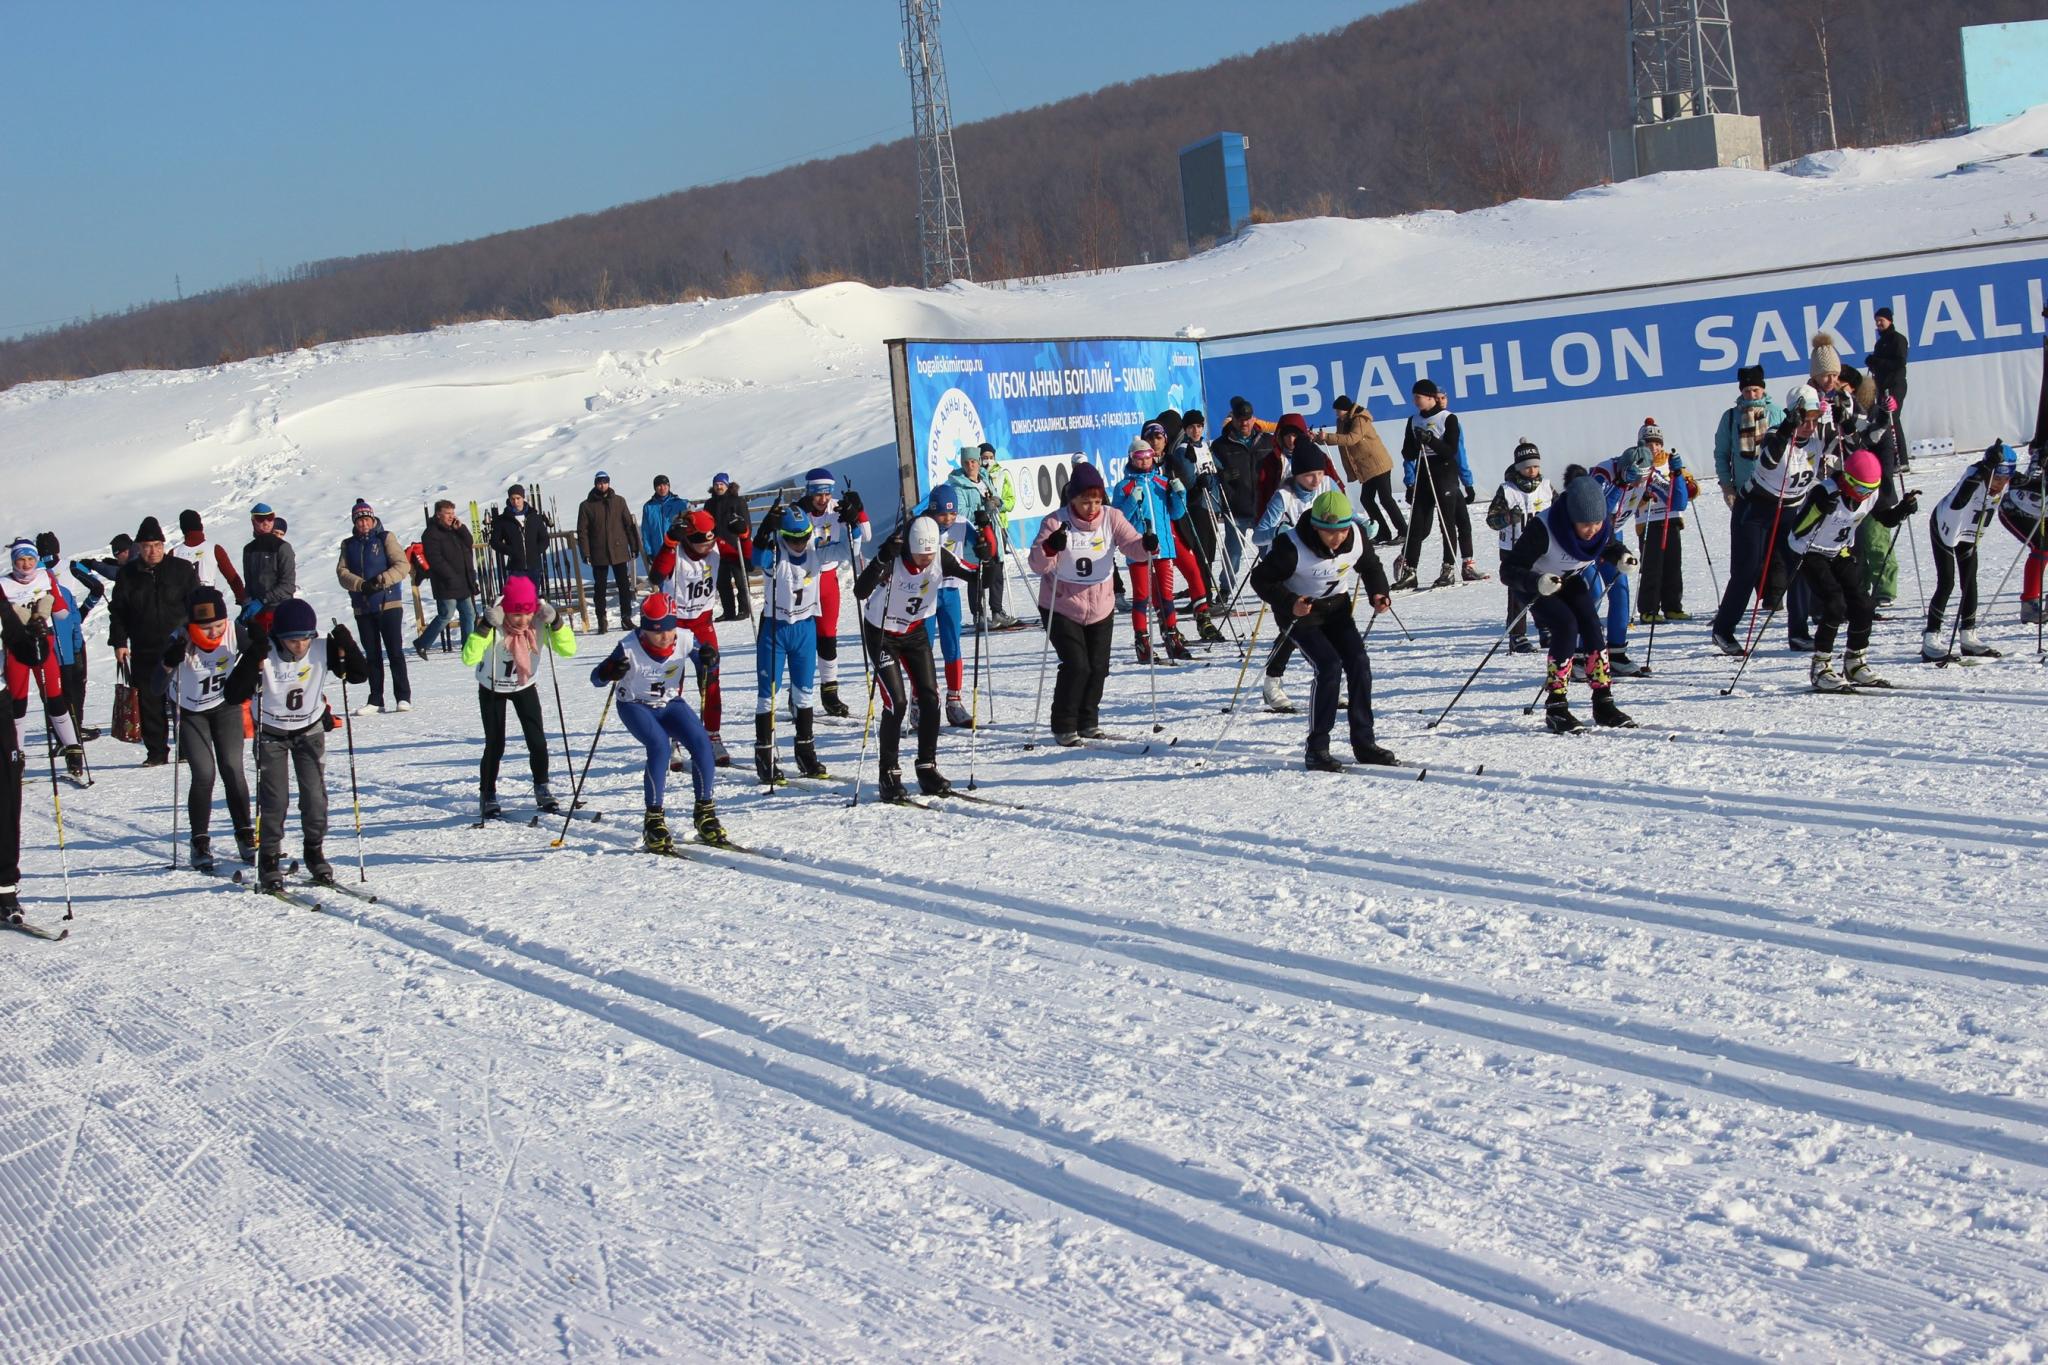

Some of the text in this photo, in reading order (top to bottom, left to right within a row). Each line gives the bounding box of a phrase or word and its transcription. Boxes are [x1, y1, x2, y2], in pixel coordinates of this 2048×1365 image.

[916, 355, 983, 377] bogaliskimircup.ru
[1278, 324, 1664, 416] BIATHLON
[987, 371, 1028, 400] КУБОК
[1029, 369, 1064, 399] АННЫ
[1064, 361, 1114, 396] БОГАЛИЙ
[1011, 415, 1069, 434] ЮЖНО-САХАЛИНСК,
[931, 424, 942, 483] УБОК
[940, 398, 961, 425] АННЫ
[1789, 470, 1814, 489] 13
[1075, 557, 1093, 578] 9
[686, 576, 714, 601] 163
[792, 588, 804, 606] 1
[1319, 579, 1341, 598] 7
[905, 597, 923, 616] 3
[198, 672, 227, 696] 15
[650, 681, 666, 698] 5
[286, 687, 304, 711] 6
